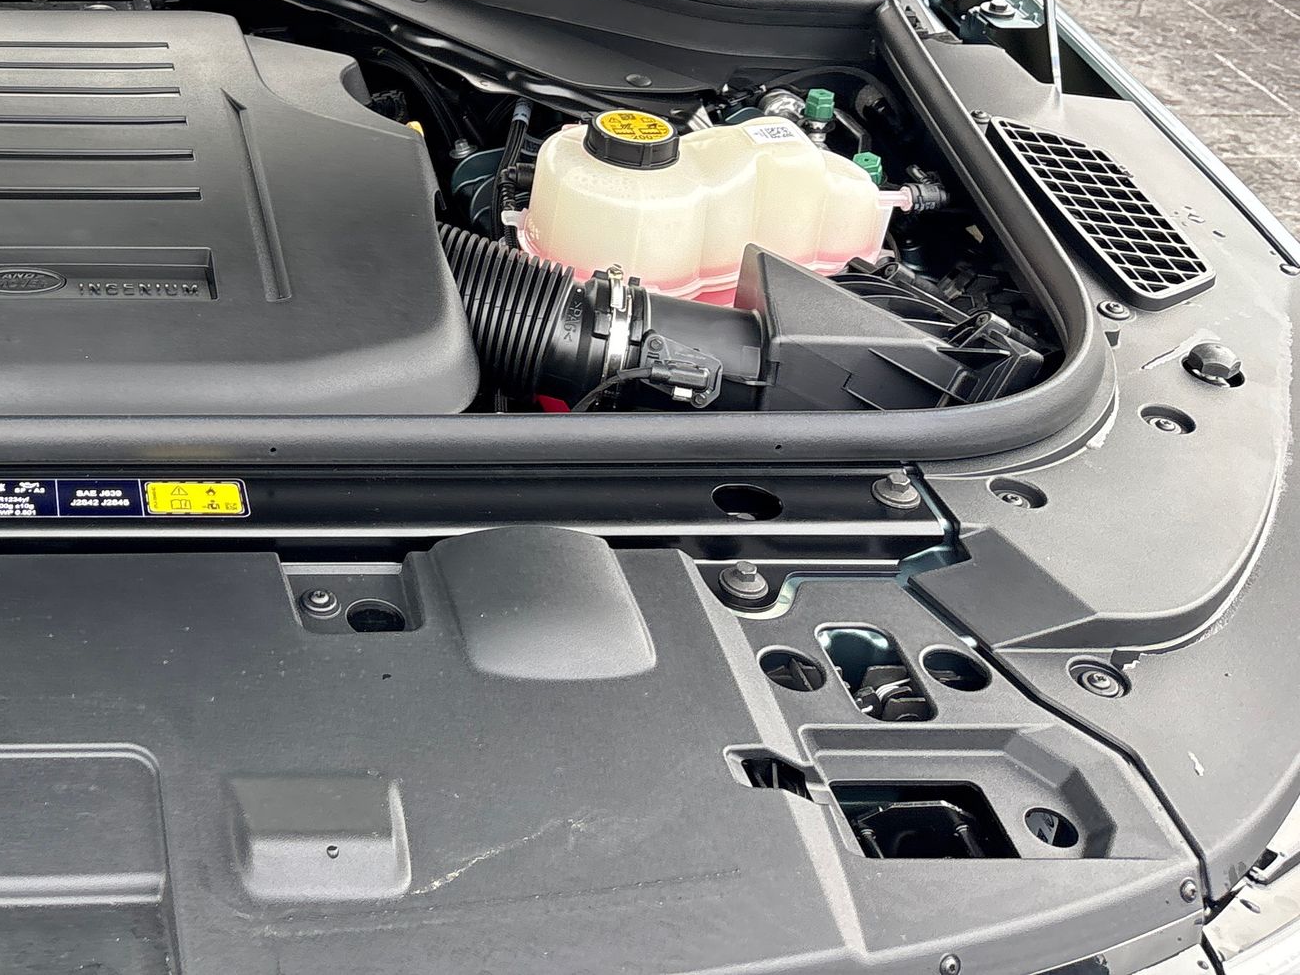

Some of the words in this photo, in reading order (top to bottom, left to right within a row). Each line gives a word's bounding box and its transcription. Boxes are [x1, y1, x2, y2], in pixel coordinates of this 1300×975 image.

[79, 282, 199, 297] INGENIUM
[75, 489, 98, 497] SAE
[98, 489, 123, 497] J639
[70, 498, 99, 506] J2842
[100, 498, 130, 506] J2845
